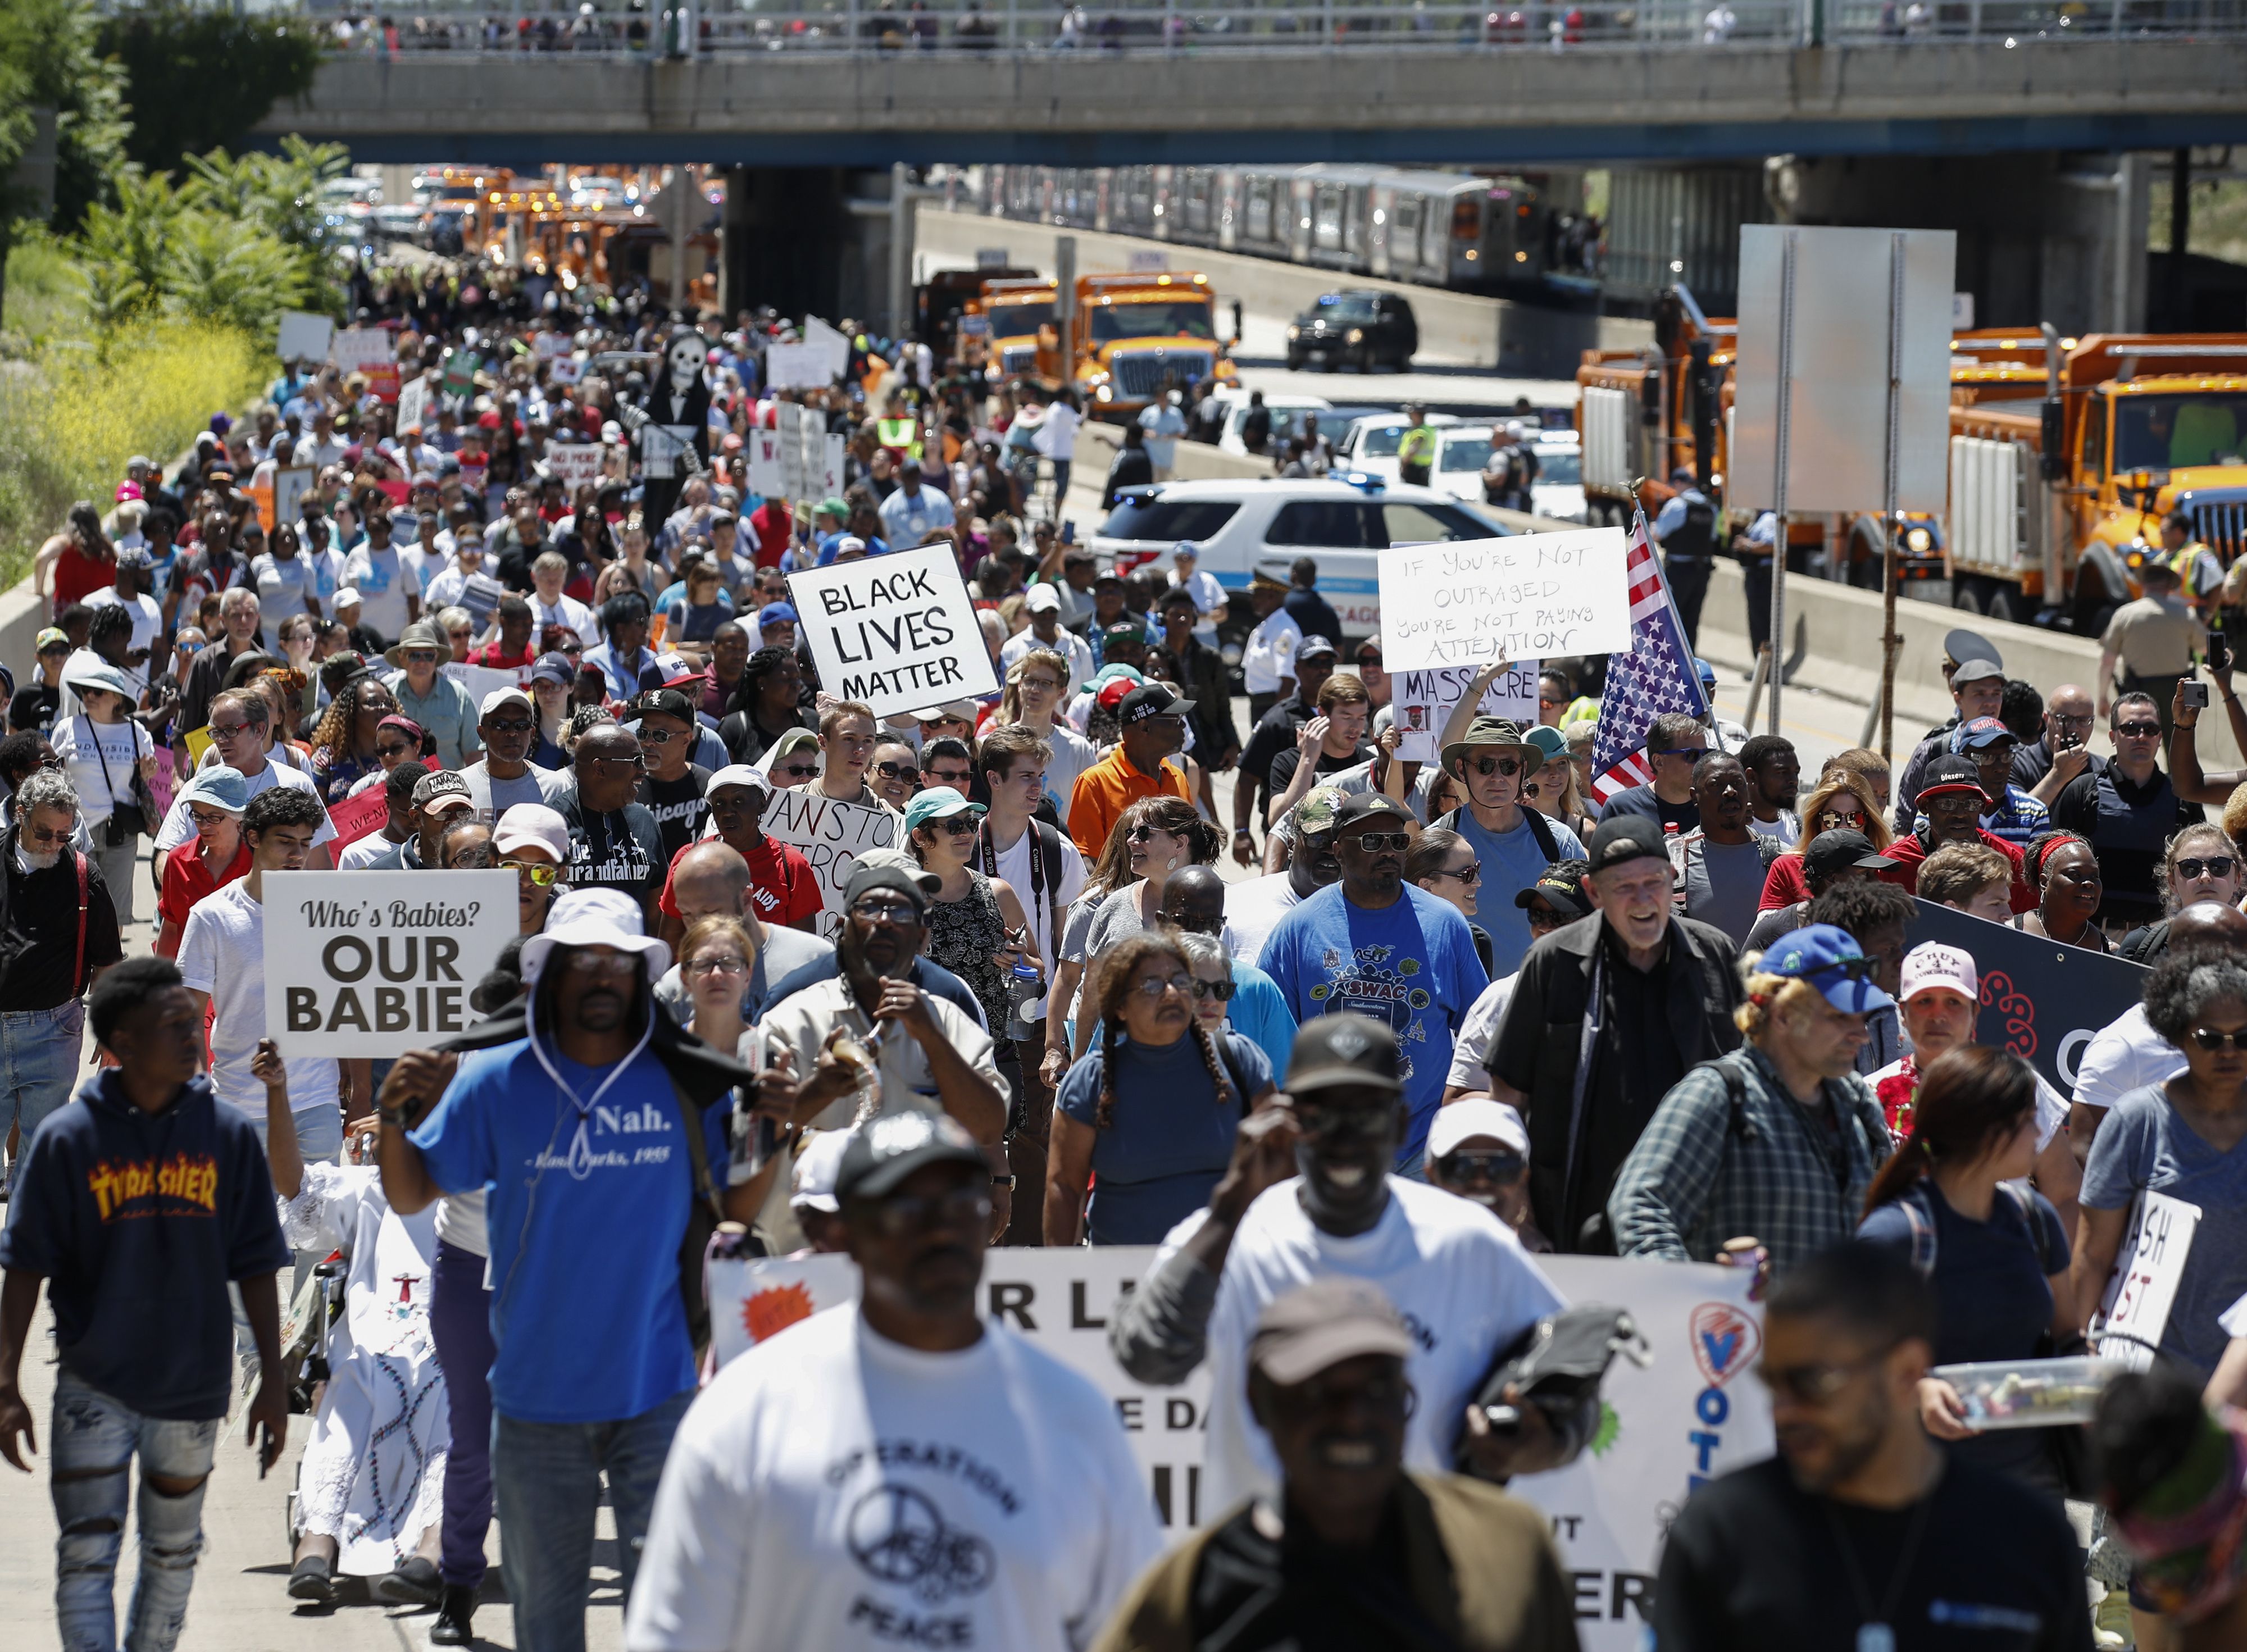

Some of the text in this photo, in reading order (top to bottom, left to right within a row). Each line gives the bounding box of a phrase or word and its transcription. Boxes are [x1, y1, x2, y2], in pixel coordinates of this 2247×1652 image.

[1404, 544, 1594, 577] IF YOU'RE NOT
[818, 568, 937, 616] BLACK
[1434, 581, 1560, 608] OUTRAGED
[831, 606, 953, 664] LIVES
[1397, 607, 1594, 638] YOU'RE NOT PAYING
[1425, 629, 1578, 663] ATTENTION
[842, 657, 963, 700] MATTER
[1405, 668, 1534, 703] MASSCRE
[1940, 773, 1965, 781] blazers
[349, 812, 371, 831] WE
[646, 797, 706, 829] hicago
[568, 838, 590, 863] he
[781, 841, 855, 891] TRO
[985, 846, 994, 874] EOS 6D
[752, 887, 780, 912] AIDS
[1545, 878, 1575, 893] Cozumel
[300, 899, 481, 928] Who's Babies?
[321, 935, 463, 983] OUR
[1915, 952, 1961, 969] CHUY
[1348, 980, 1408, 1000] SWAC
[594, 1103, 672, 1135] Nah.
[2121, 1200, 2173, 1266] ASH
[1689, 1330, 1737, 1497] VOT
[825, 1439, 1018, 1515] OPERATION
[847, 1594, 973, 1650] PEACE
